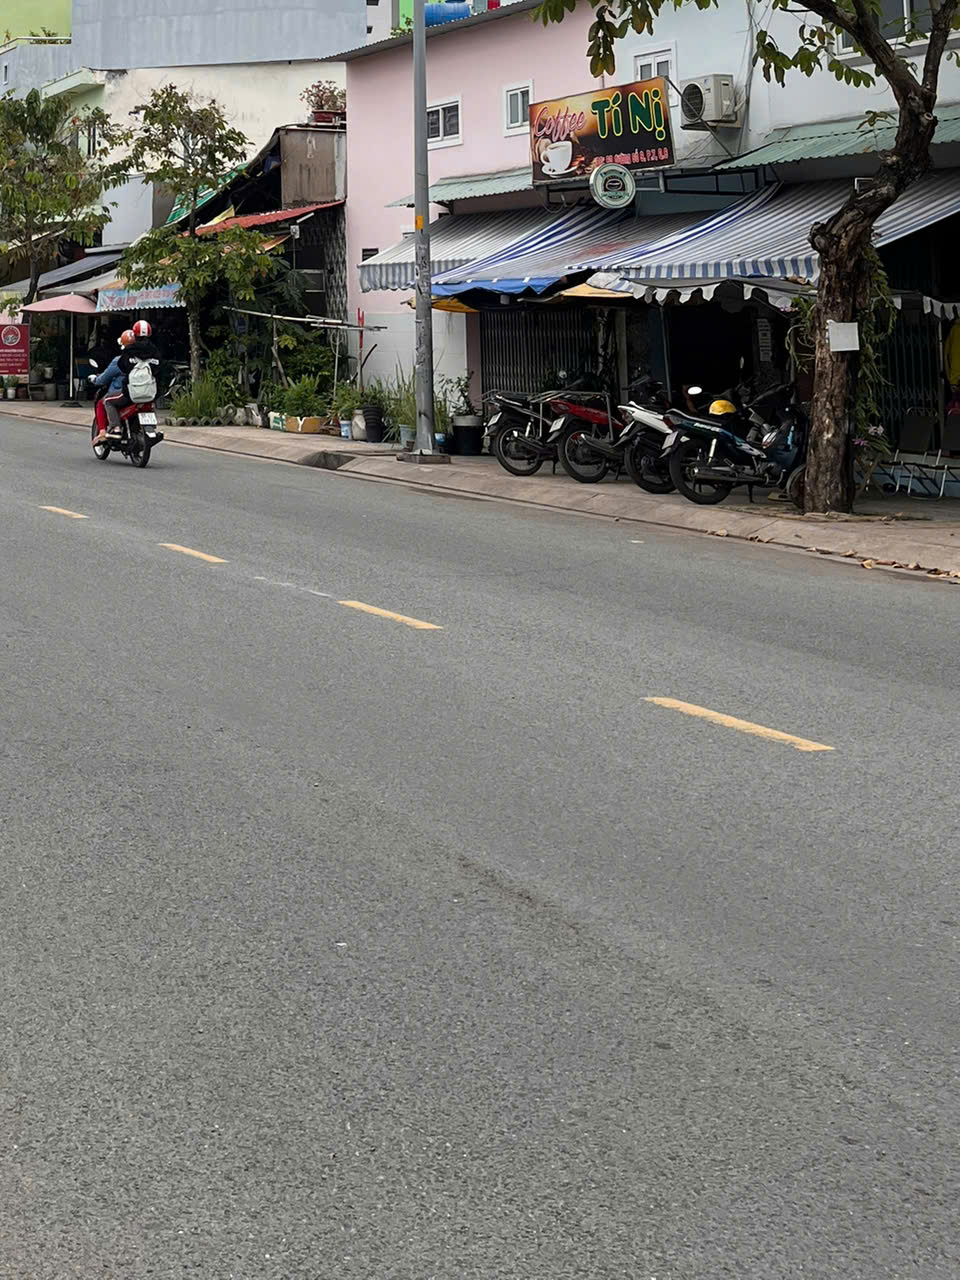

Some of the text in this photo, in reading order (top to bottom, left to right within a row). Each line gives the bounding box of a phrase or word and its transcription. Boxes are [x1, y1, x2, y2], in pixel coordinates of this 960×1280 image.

[534, 87, 666, 142] Coffee Tí Nị
